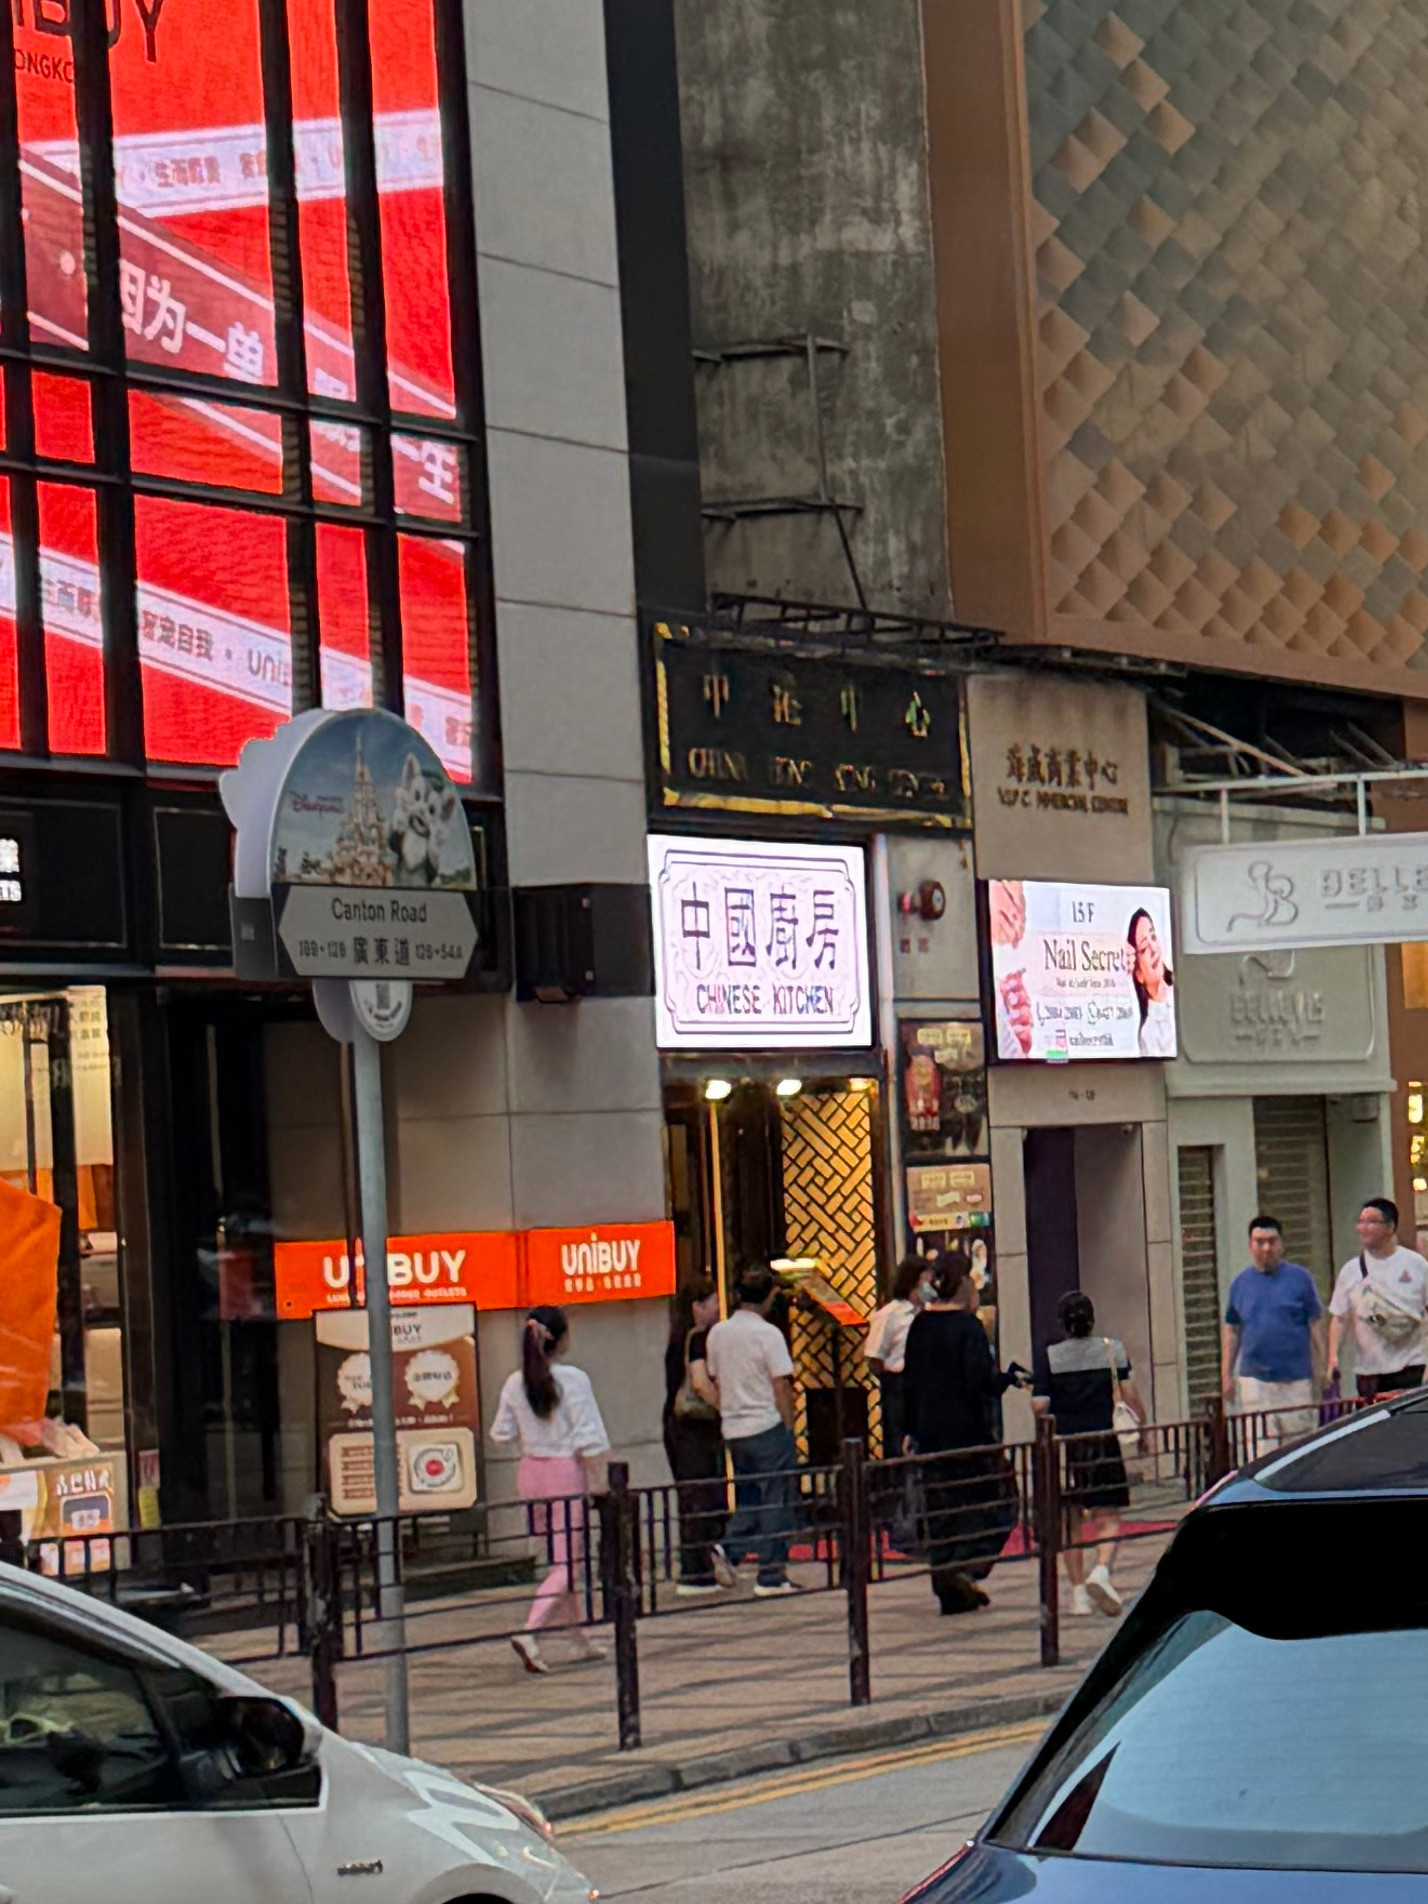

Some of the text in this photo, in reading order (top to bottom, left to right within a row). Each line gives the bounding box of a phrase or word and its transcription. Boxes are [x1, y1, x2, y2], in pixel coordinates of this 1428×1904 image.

[332, 897, 428, 923] Canton Road
[680, 880, 840, 971] 中國廚房
[353, 936, 410, 967] 廣東道
[1043, 938, 1126, 973] Nail Secret
[696, 983, 834, 1016] CHINESE KITCHEN
